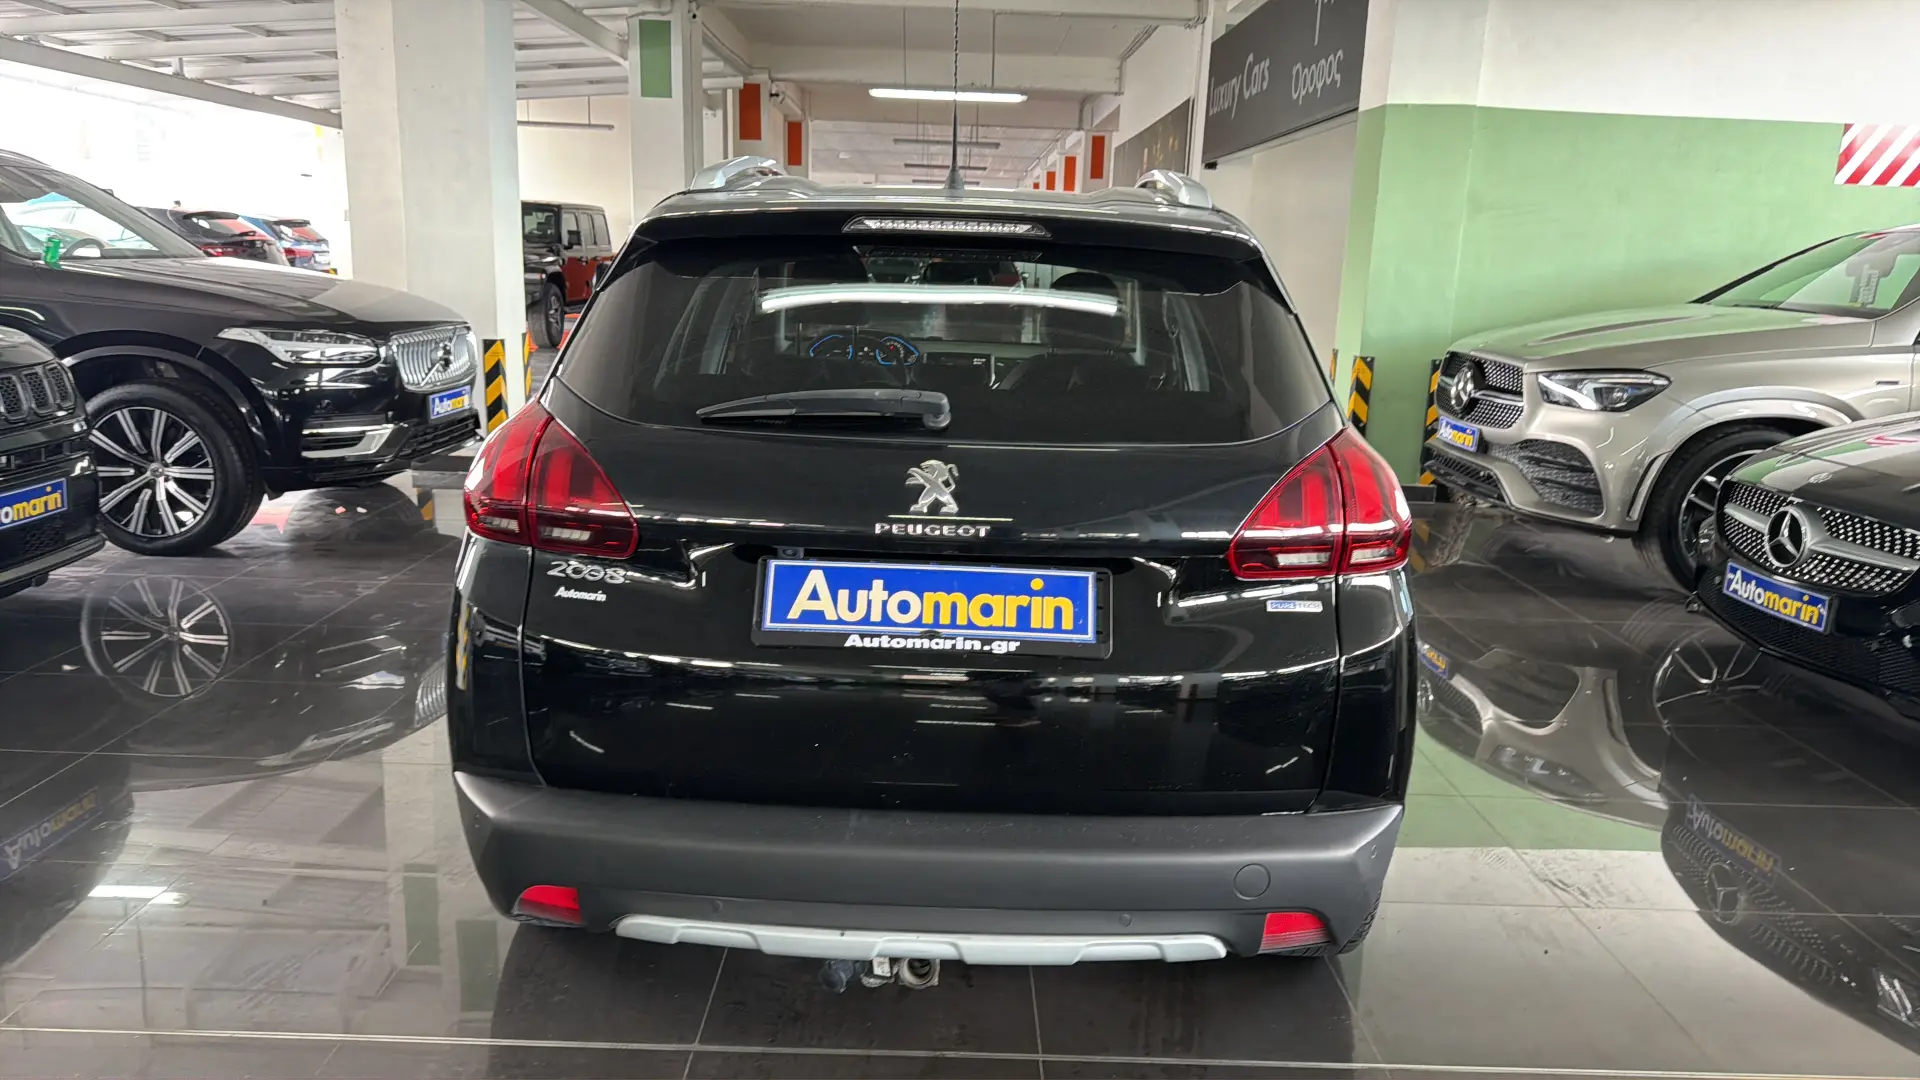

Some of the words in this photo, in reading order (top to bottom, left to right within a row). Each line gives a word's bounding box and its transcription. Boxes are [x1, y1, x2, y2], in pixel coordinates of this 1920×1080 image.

[1209, 74, 1242, 120] Luxury
[1243, 52, 1270, 100] Cars
[0, 486, 62, 524] omarin
[874, 522, 991, 537] PEUGEOT
[546, 560, 626, 584] 2008
[554, 586, 607, 602] Automarin
[786, 569, 1074, 630] Automarin
[1729, 570, 1820, 625] Automarin
[843, 633, 1020, 654] Automarin.gr
